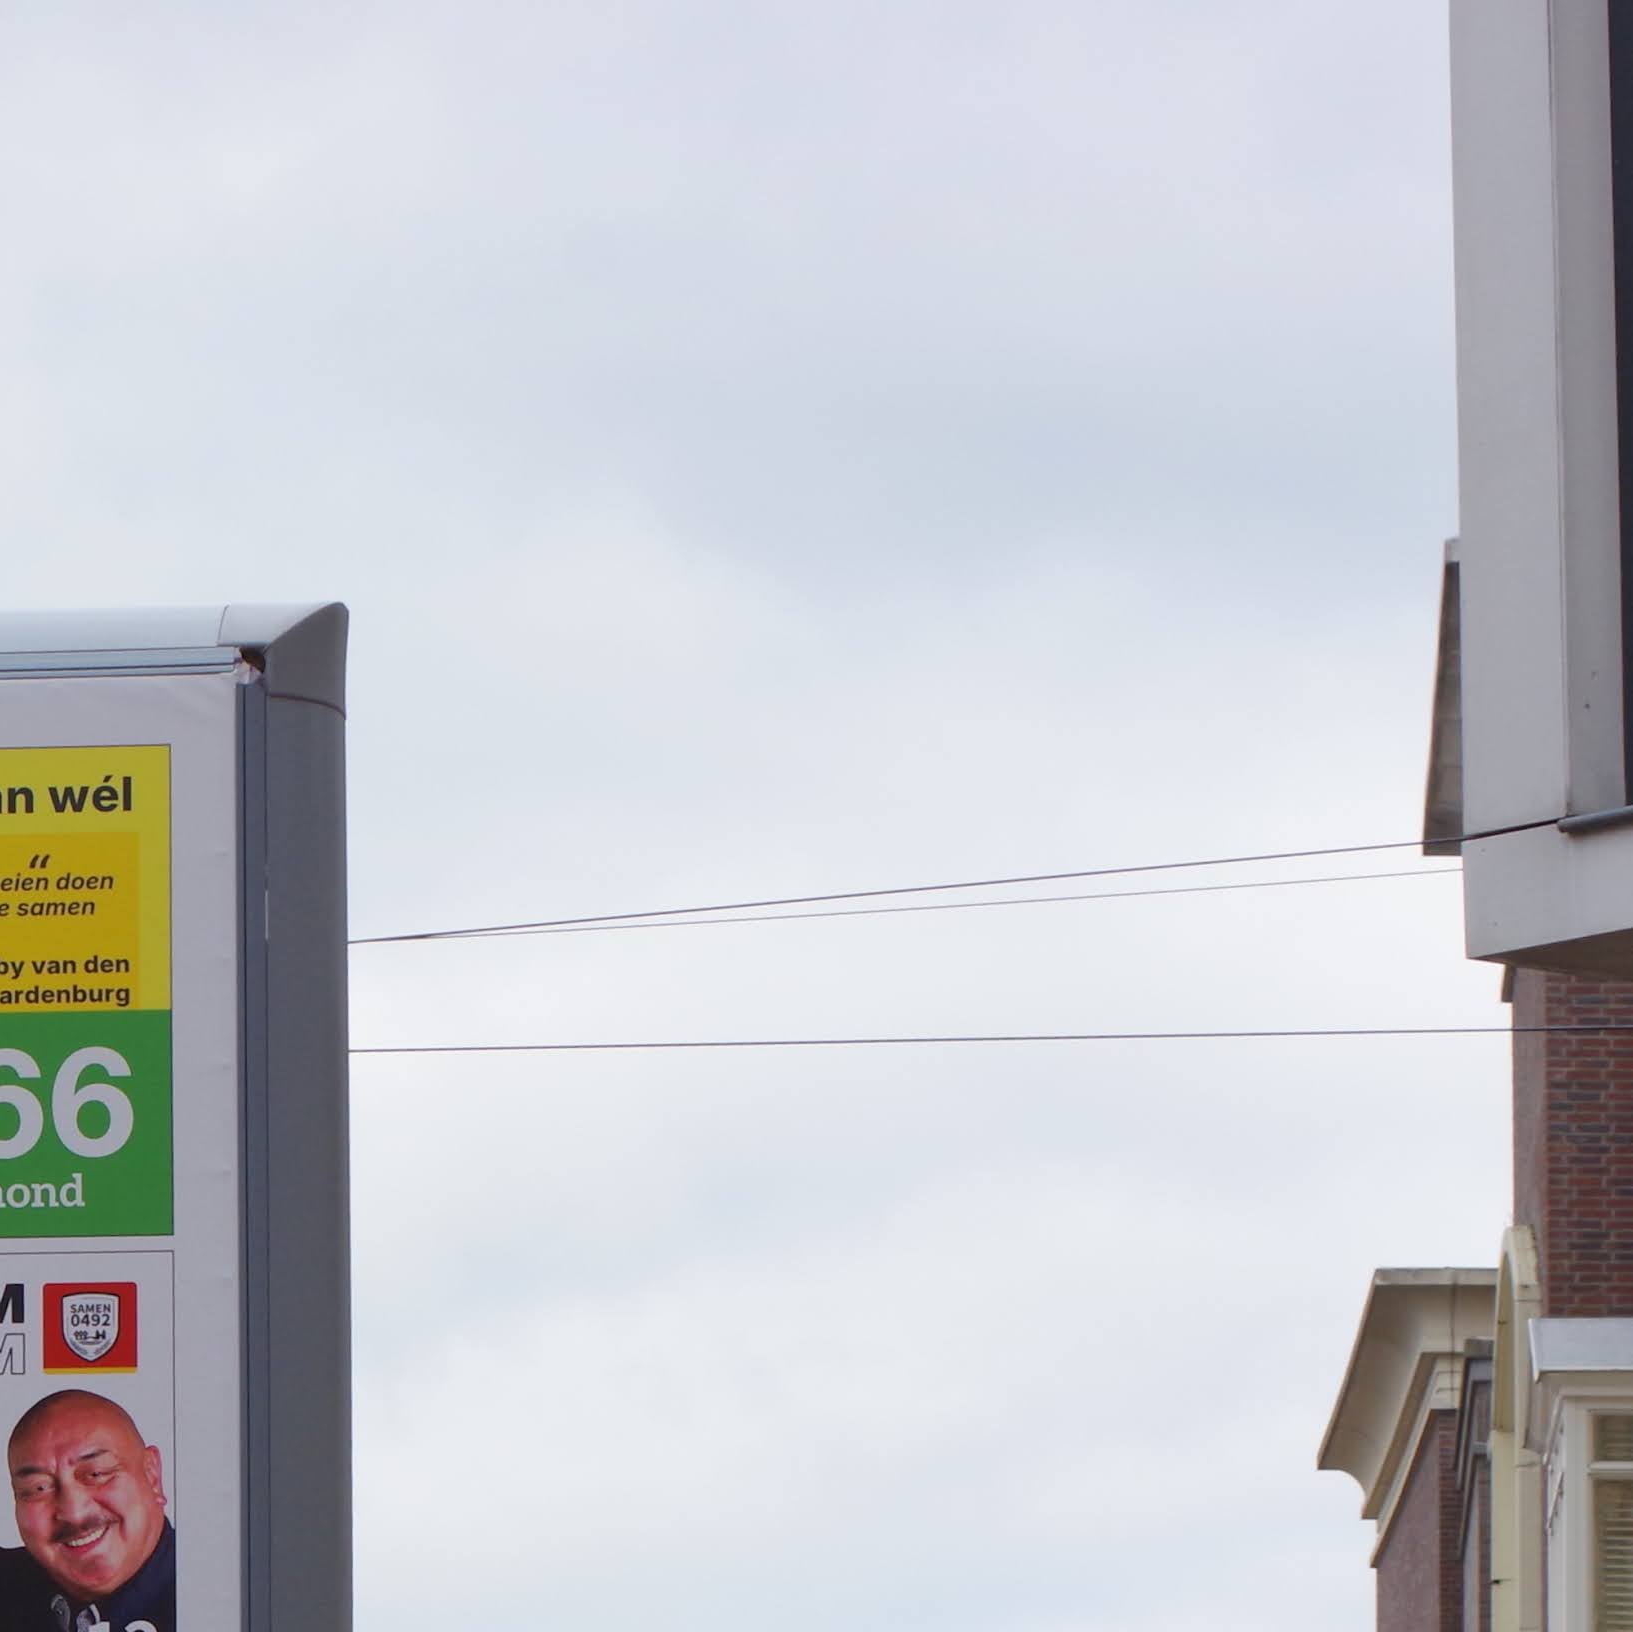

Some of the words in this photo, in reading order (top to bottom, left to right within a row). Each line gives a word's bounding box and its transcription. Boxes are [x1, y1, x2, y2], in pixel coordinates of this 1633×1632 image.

[48, 774, 133, 812] wél
[56, 869, 114, 892] doen
[17, 896, 96, 916] samen
[31, 957, 75, 975] van
[80, 954, 130, 975] den
[70, 1303, 112, 1316] SAMEN
[70, 1313, 112, 1328] 0492
